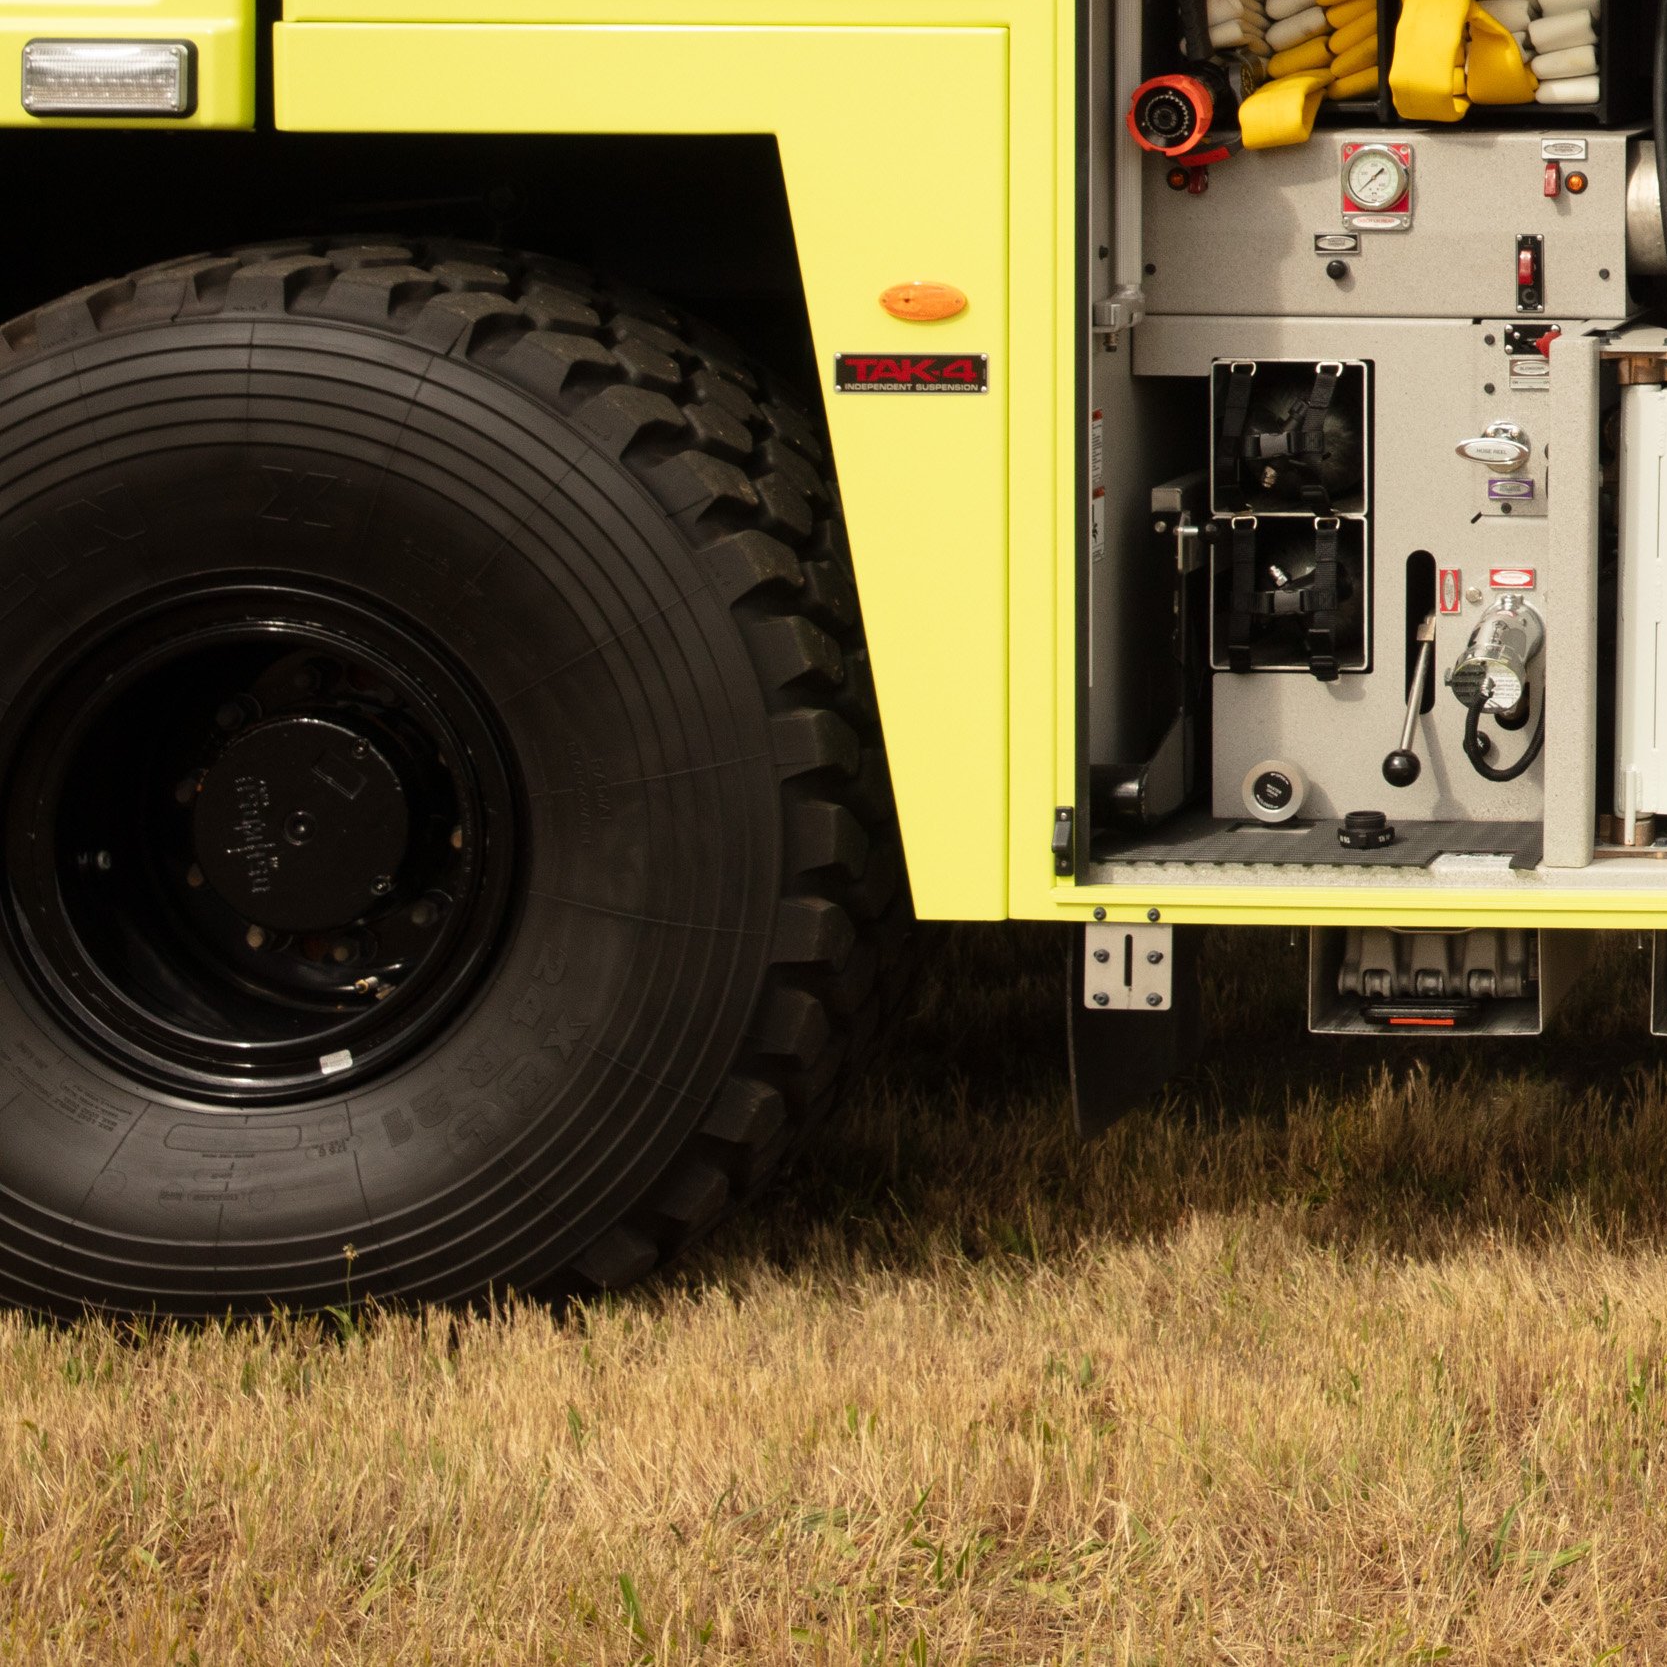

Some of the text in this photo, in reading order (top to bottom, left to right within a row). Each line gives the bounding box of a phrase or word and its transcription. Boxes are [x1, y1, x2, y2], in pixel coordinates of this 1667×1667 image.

[844, 358, 978, 384] TAK-4
[844, 383, 979, 391] INDEPENDENT SUSPENSION
